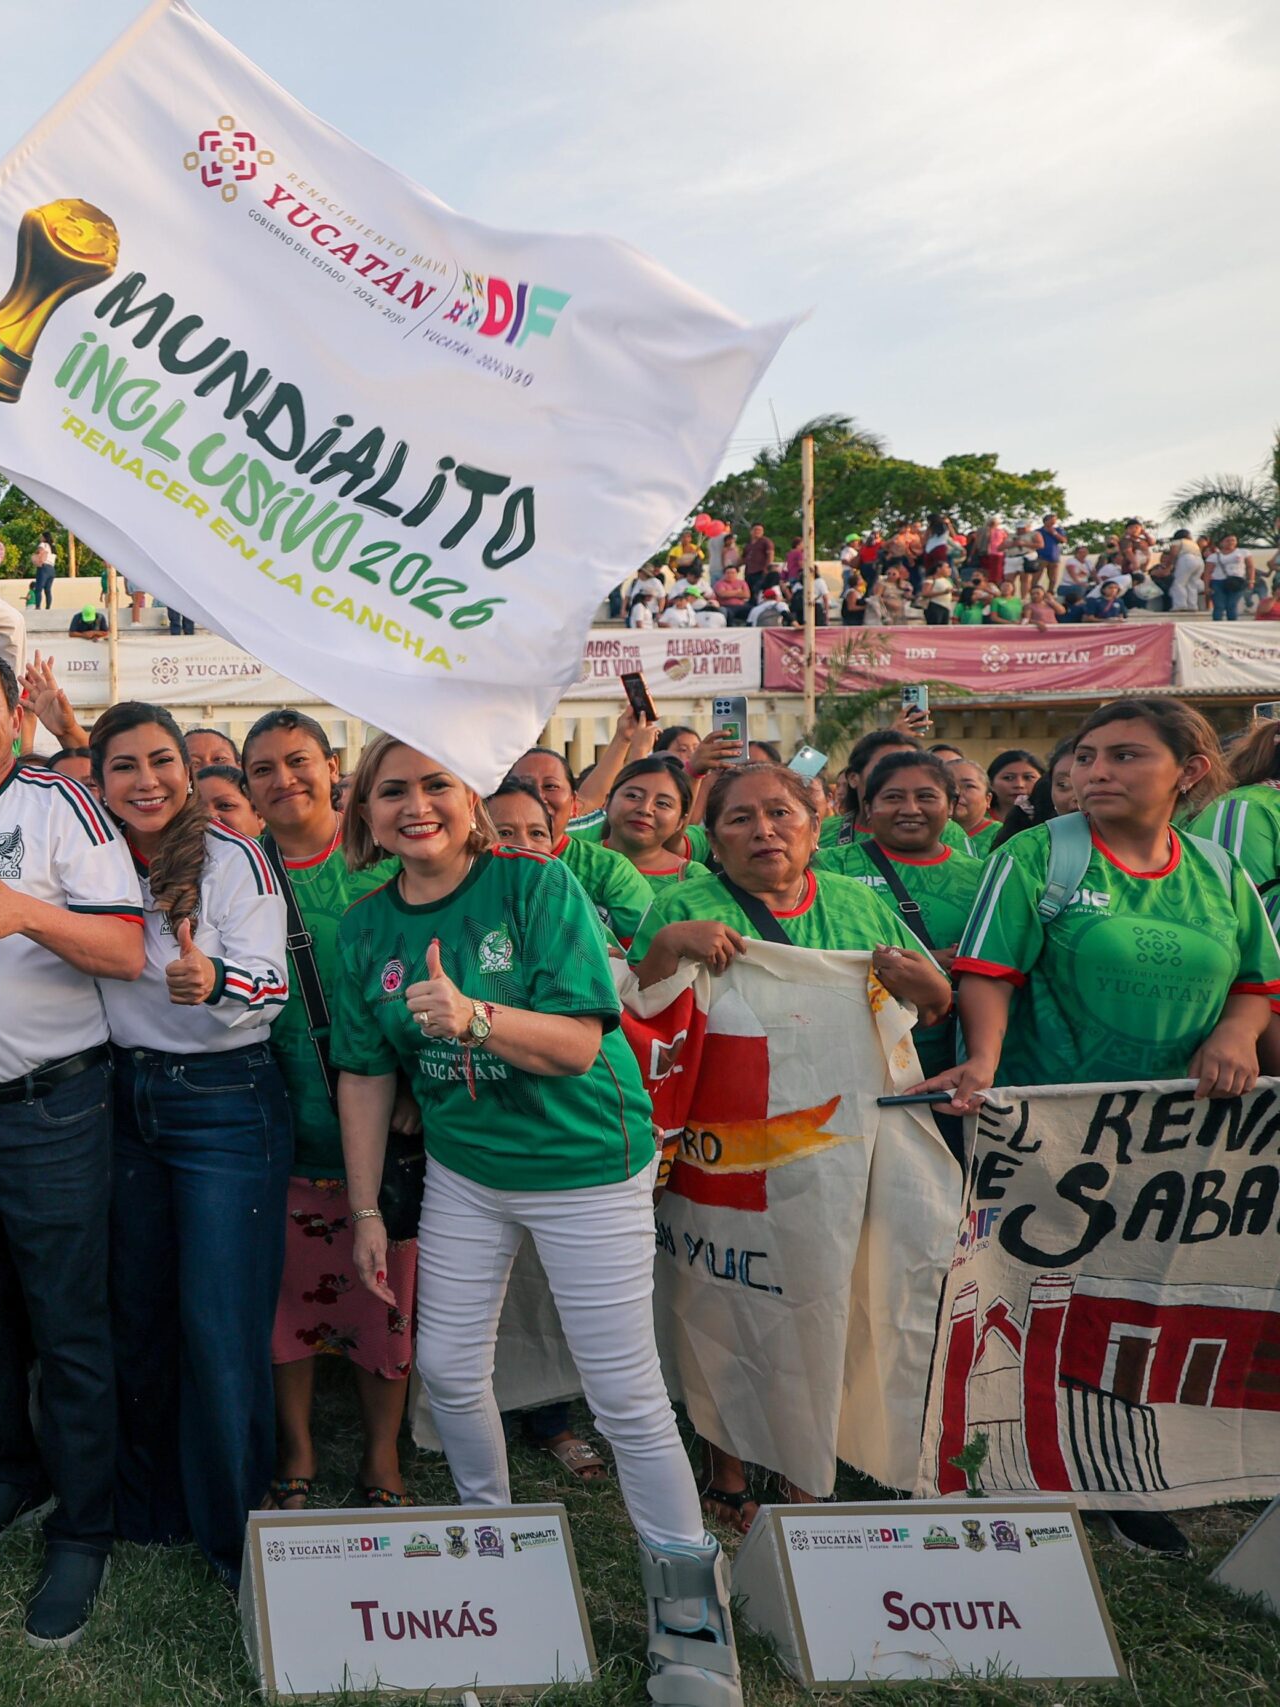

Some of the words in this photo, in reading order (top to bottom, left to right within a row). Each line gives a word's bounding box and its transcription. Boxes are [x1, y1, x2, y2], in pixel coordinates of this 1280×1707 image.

[286, 172, 407, 257] RENACIMIENTO
[410, 253, 448, 277] MAYA
[262, 183, 438, 310] YUCATÁN
[248, 209, 295, 247] GOBIERNO
[293, 243, 311, 260] DEL
[311, 256, 346, 283] ESTADO
[352, 286, 378, 309] 2024
[382, 307, 406, 325] 2030
[477, 275, 572, 349] DIF
[208, 516, 259, 561] EN
[257, 558, 303, 596] LA
[348, 540, 508, 630] 2026
[622, 646, 640, 658] POR
[667, 639, 721, 657] ALIADOS
[722, 643, 740, 655] POR
[905, 648, 937, 659] IDEY
[1103, 644, 1137, 657] IDEY
[67, 660, 99, 672] IDEY
[693, 657, 709, 674] LA
[713, 656, 743, 674] VIDA
[1014, 651, 1090, 665] YUCATÁN
[185, 663, 262, 677] YUCATÁN
[593, 660, 609, 677] LA
[613, 659, 644, 677] VIDA
[1097, 977, 1213, 1003] YUCATÁN
[998, 1161, 1280, 1269] SABA
[289, 1544, 341, 1555] YUCATÁN
[360, 1536, 391, 1552] DIF
[812, 1534, 862, 1545] YUCATÁN
[879, 1528, 910, 1542] DIF
